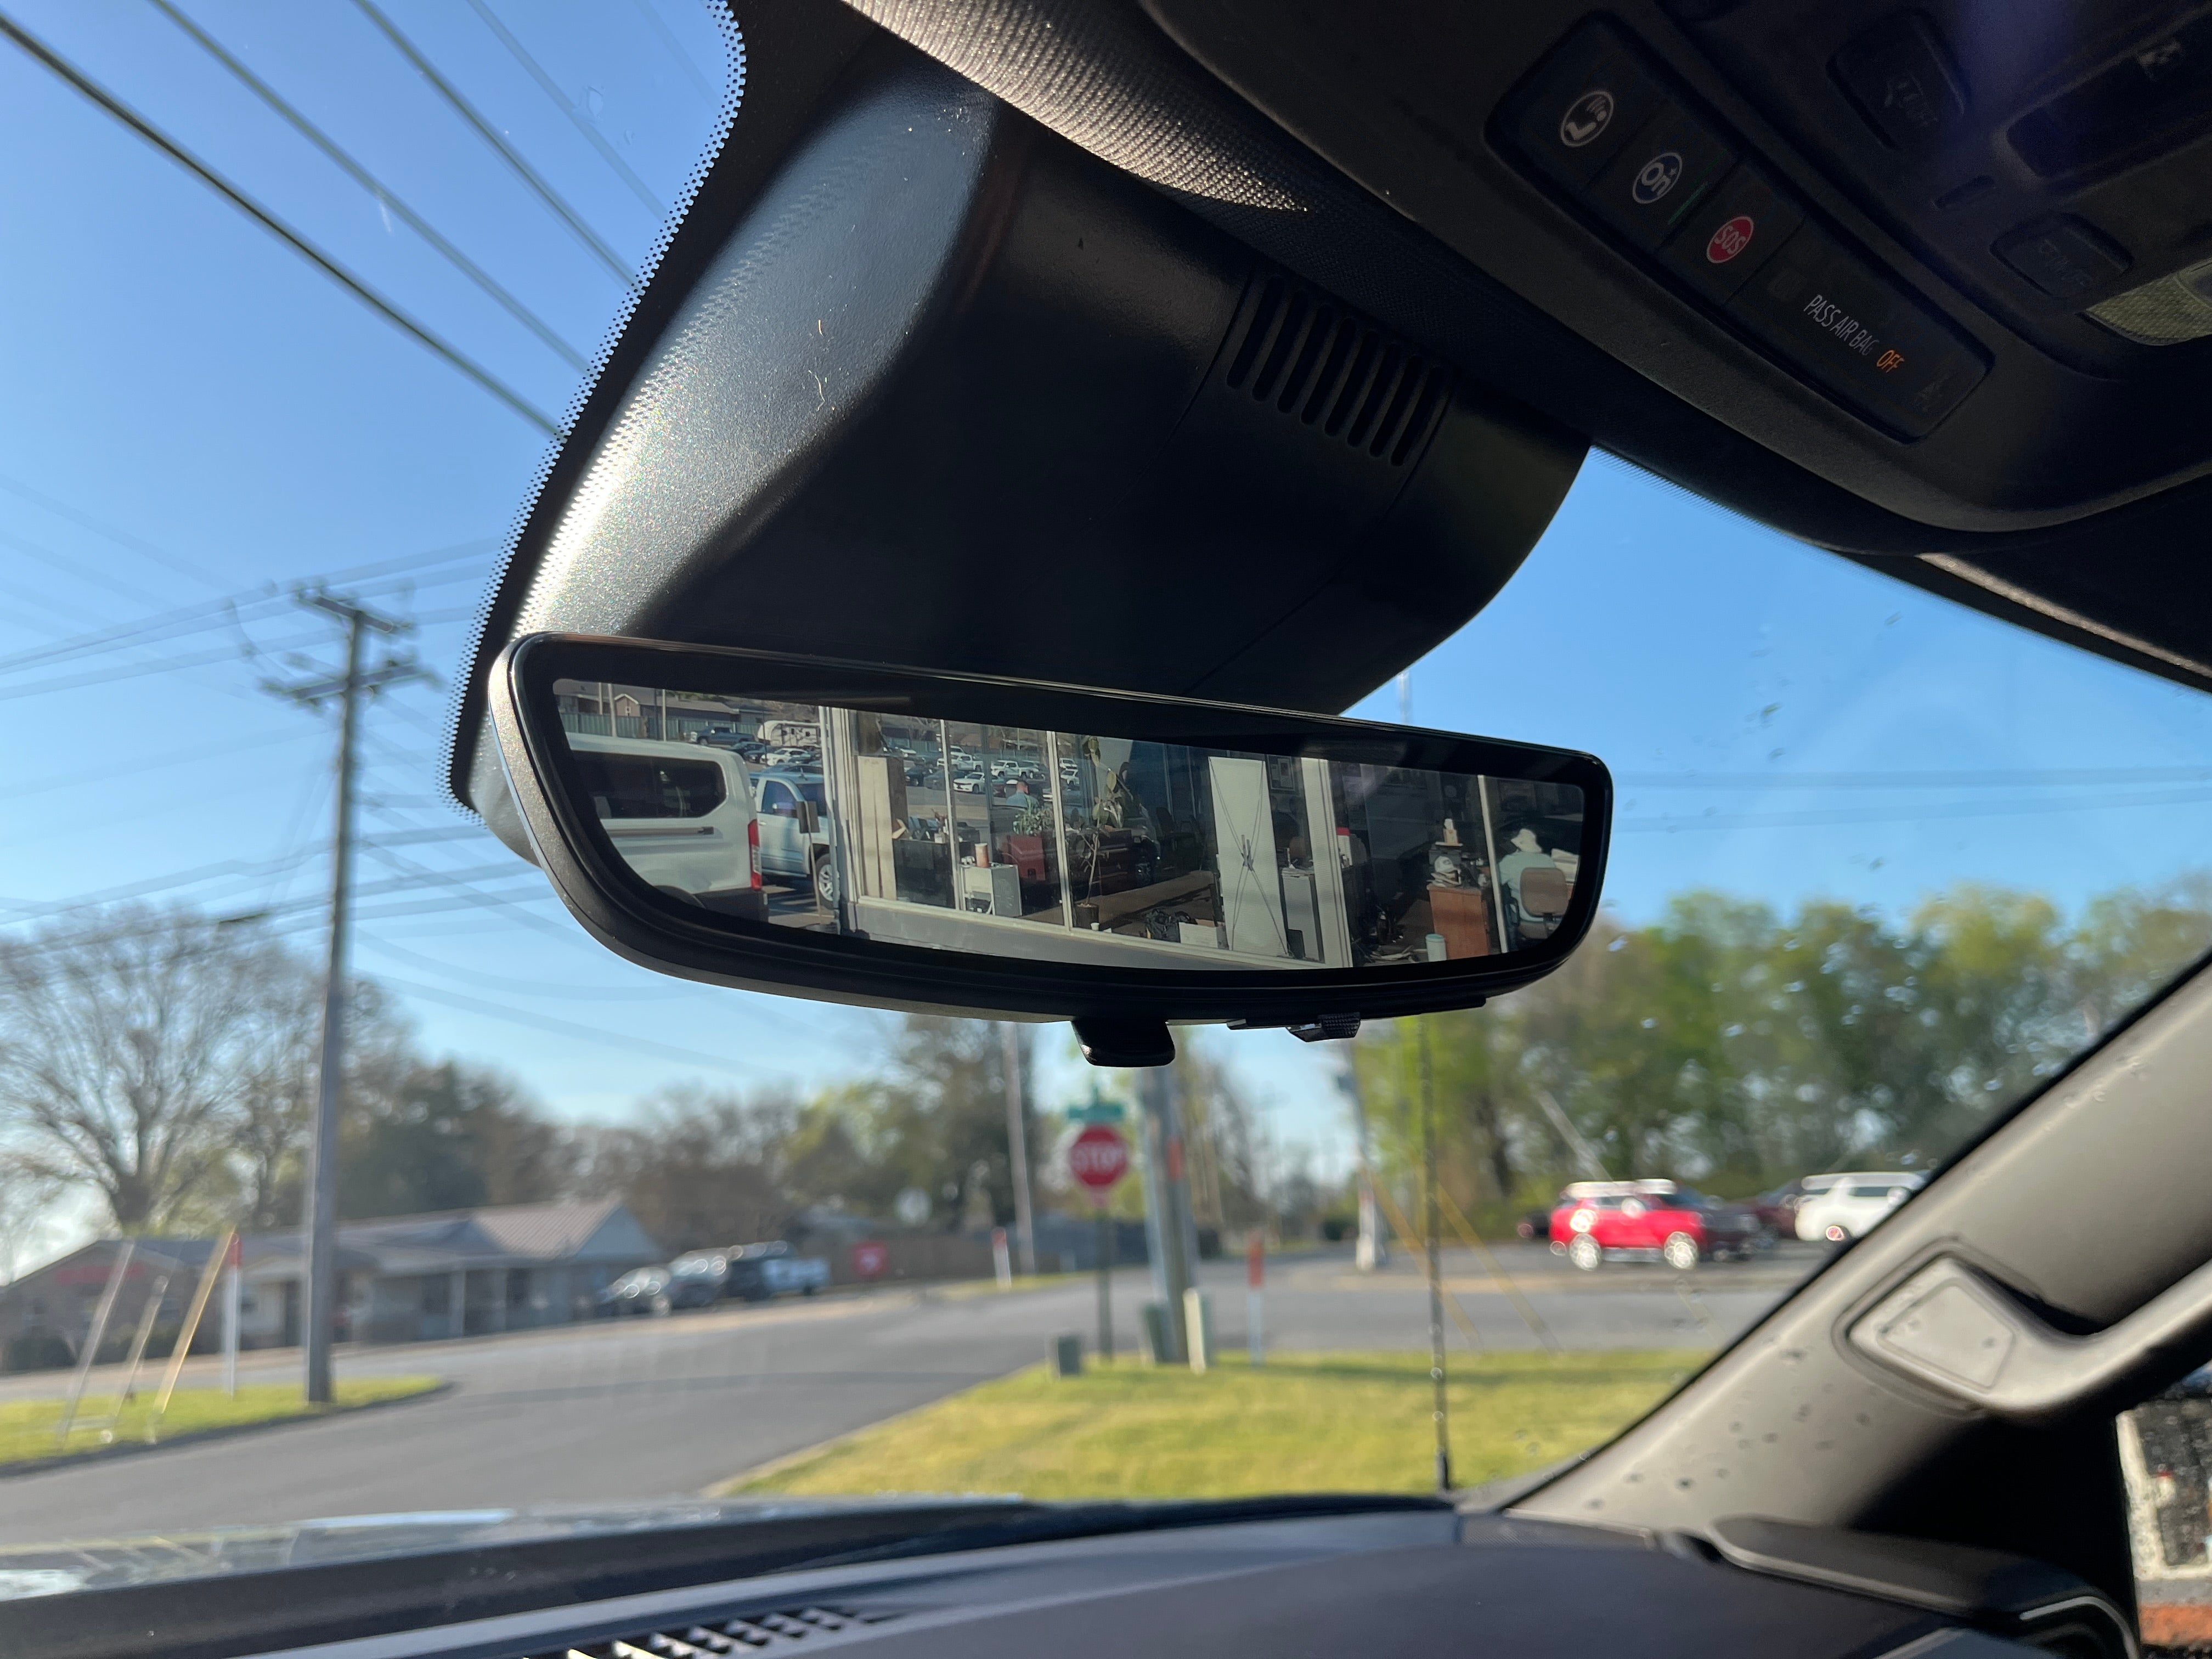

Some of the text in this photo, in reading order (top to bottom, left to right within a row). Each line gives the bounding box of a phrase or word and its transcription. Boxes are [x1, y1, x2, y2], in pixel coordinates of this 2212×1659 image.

[1641, 162, 1671, 195] On
[1714, 225, 1746, 255] SOS
[1803, 294, 1841, 327] PASS
[1876, 349, 1905, 373] OFF
[1073, 1143, 1124, 1171] STOP
